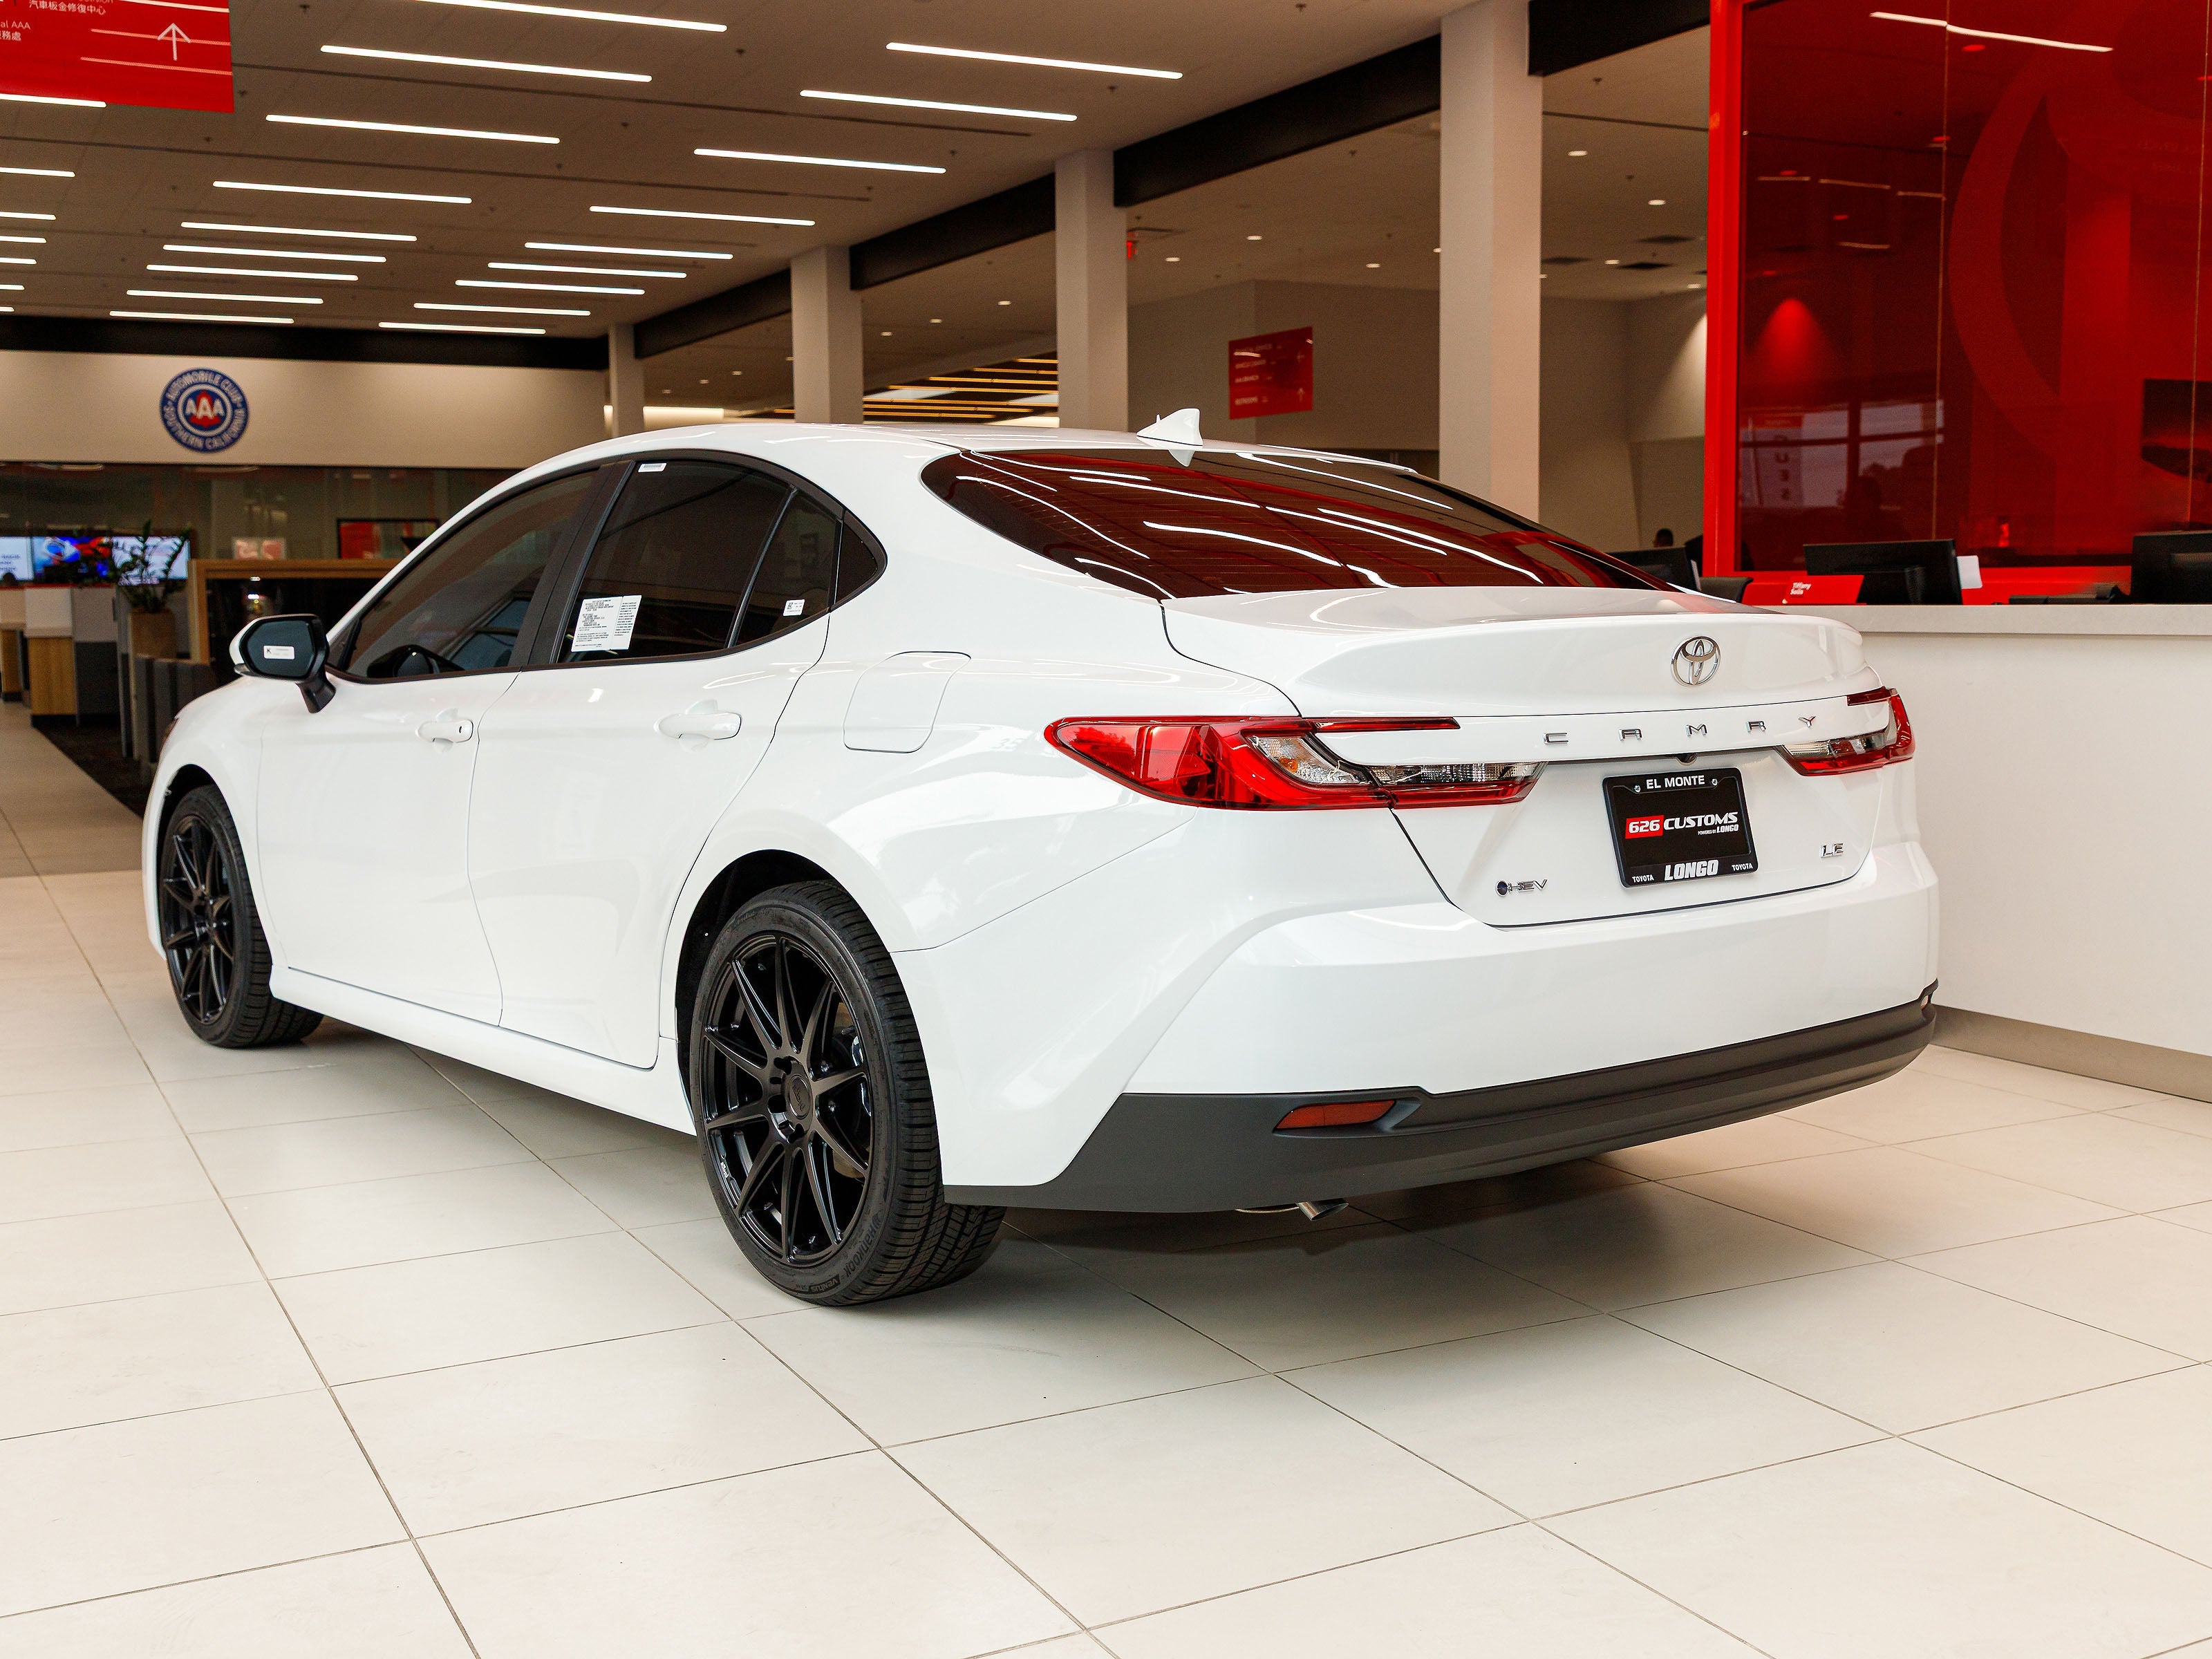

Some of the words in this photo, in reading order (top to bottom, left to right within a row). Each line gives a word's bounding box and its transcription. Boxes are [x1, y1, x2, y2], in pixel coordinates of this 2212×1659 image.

[11, 21, 31, 30] AAA
[0, 30, 21, 41] 務處
[185, 397, 225, 420] AAA
[1544, 715, 1817, 744] CAMRY
[1646, 780, 1661, 789] EL
[1665, 775, 1705, 788] MONTE
[1629, 819, 1660, 834] 626
[1663, 812, 1738, 830] CUSTOMS
[1716, 824, 1739, 834] LONGO
[1819, 843, 1844, 858] LE
[1631, 874, 1655, 883] TOYOTA
[1664, 859, 1719, 881] LONGO
[1731, 863, 1754, 872] TOYOTA
